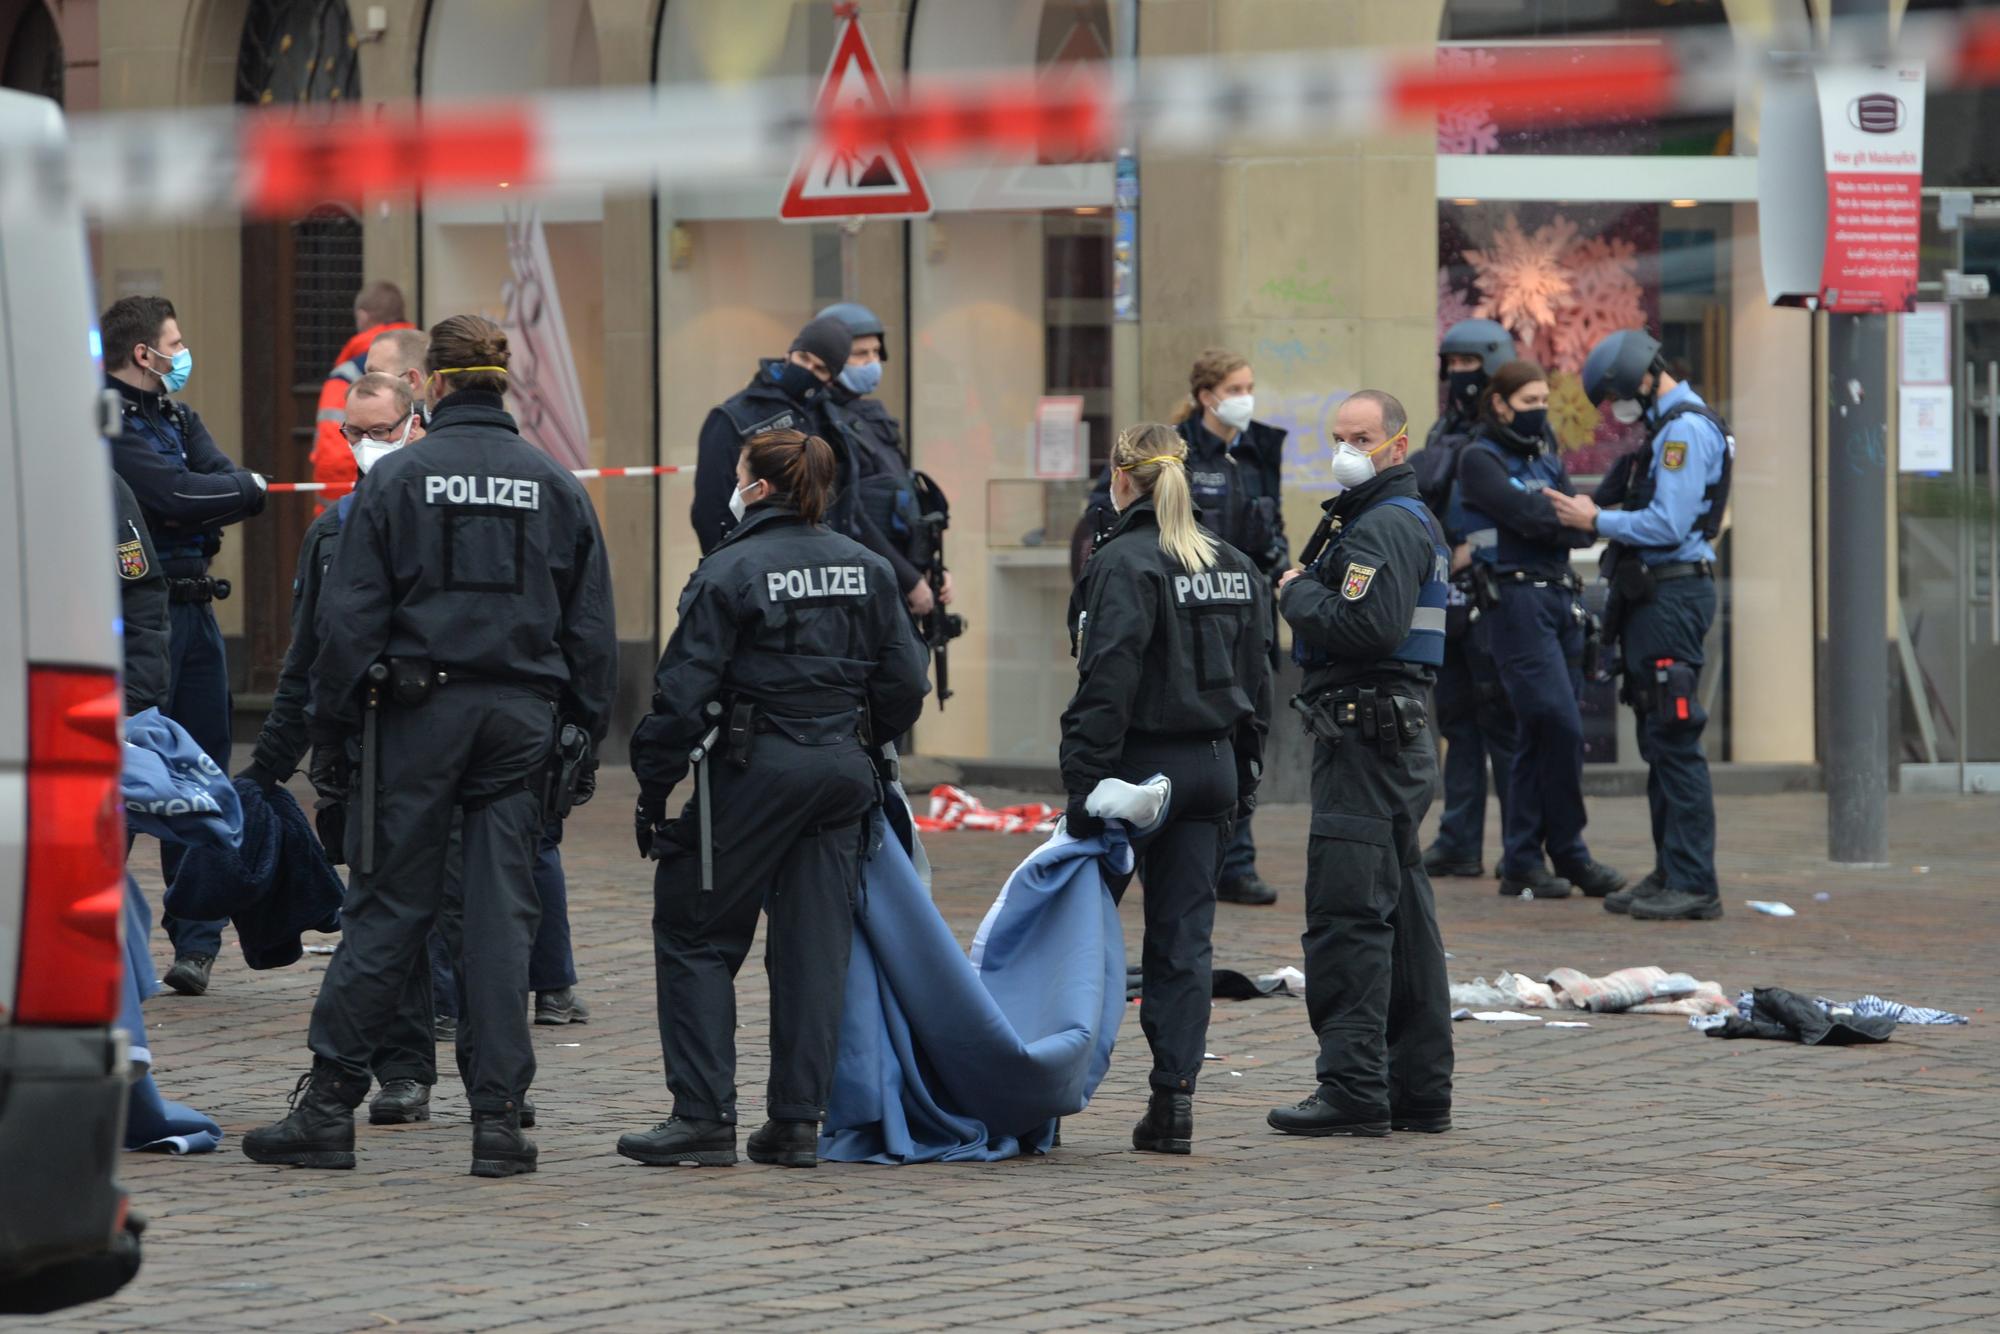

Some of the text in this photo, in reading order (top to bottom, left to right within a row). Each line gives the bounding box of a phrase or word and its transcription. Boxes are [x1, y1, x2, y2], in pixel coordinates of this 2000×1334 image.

[425, 475, 540, 510] POLIZEI
[766, 566, 867, 602] POLIZEI
[1174, 571, 1252, 603] POLIZEI
